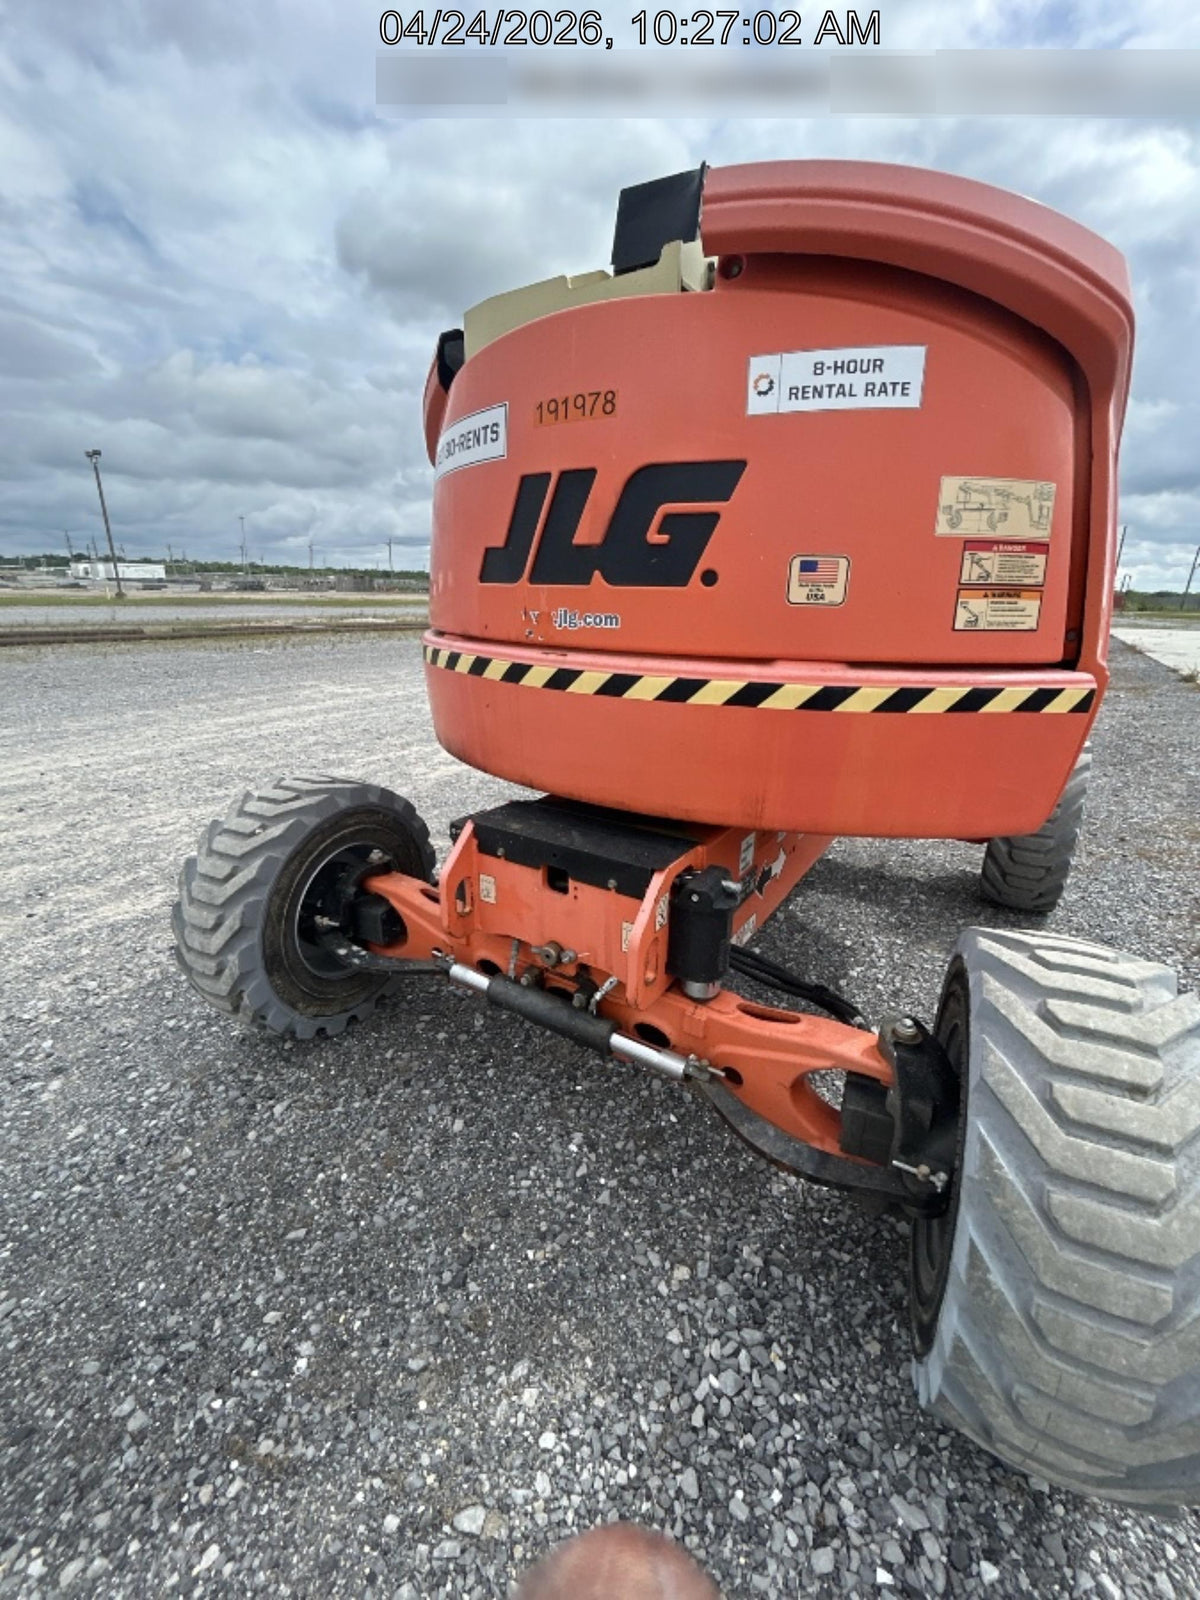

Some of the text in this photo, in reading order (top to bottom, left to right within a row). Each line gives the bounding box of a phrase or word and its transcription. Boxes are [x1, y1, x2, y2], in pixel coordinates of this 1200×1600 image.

[813, 358, 885, 376] 8-HOUR
[788, 382, 912, 401] RENTAL RATE
[536, 390, 616, 424] 191978
